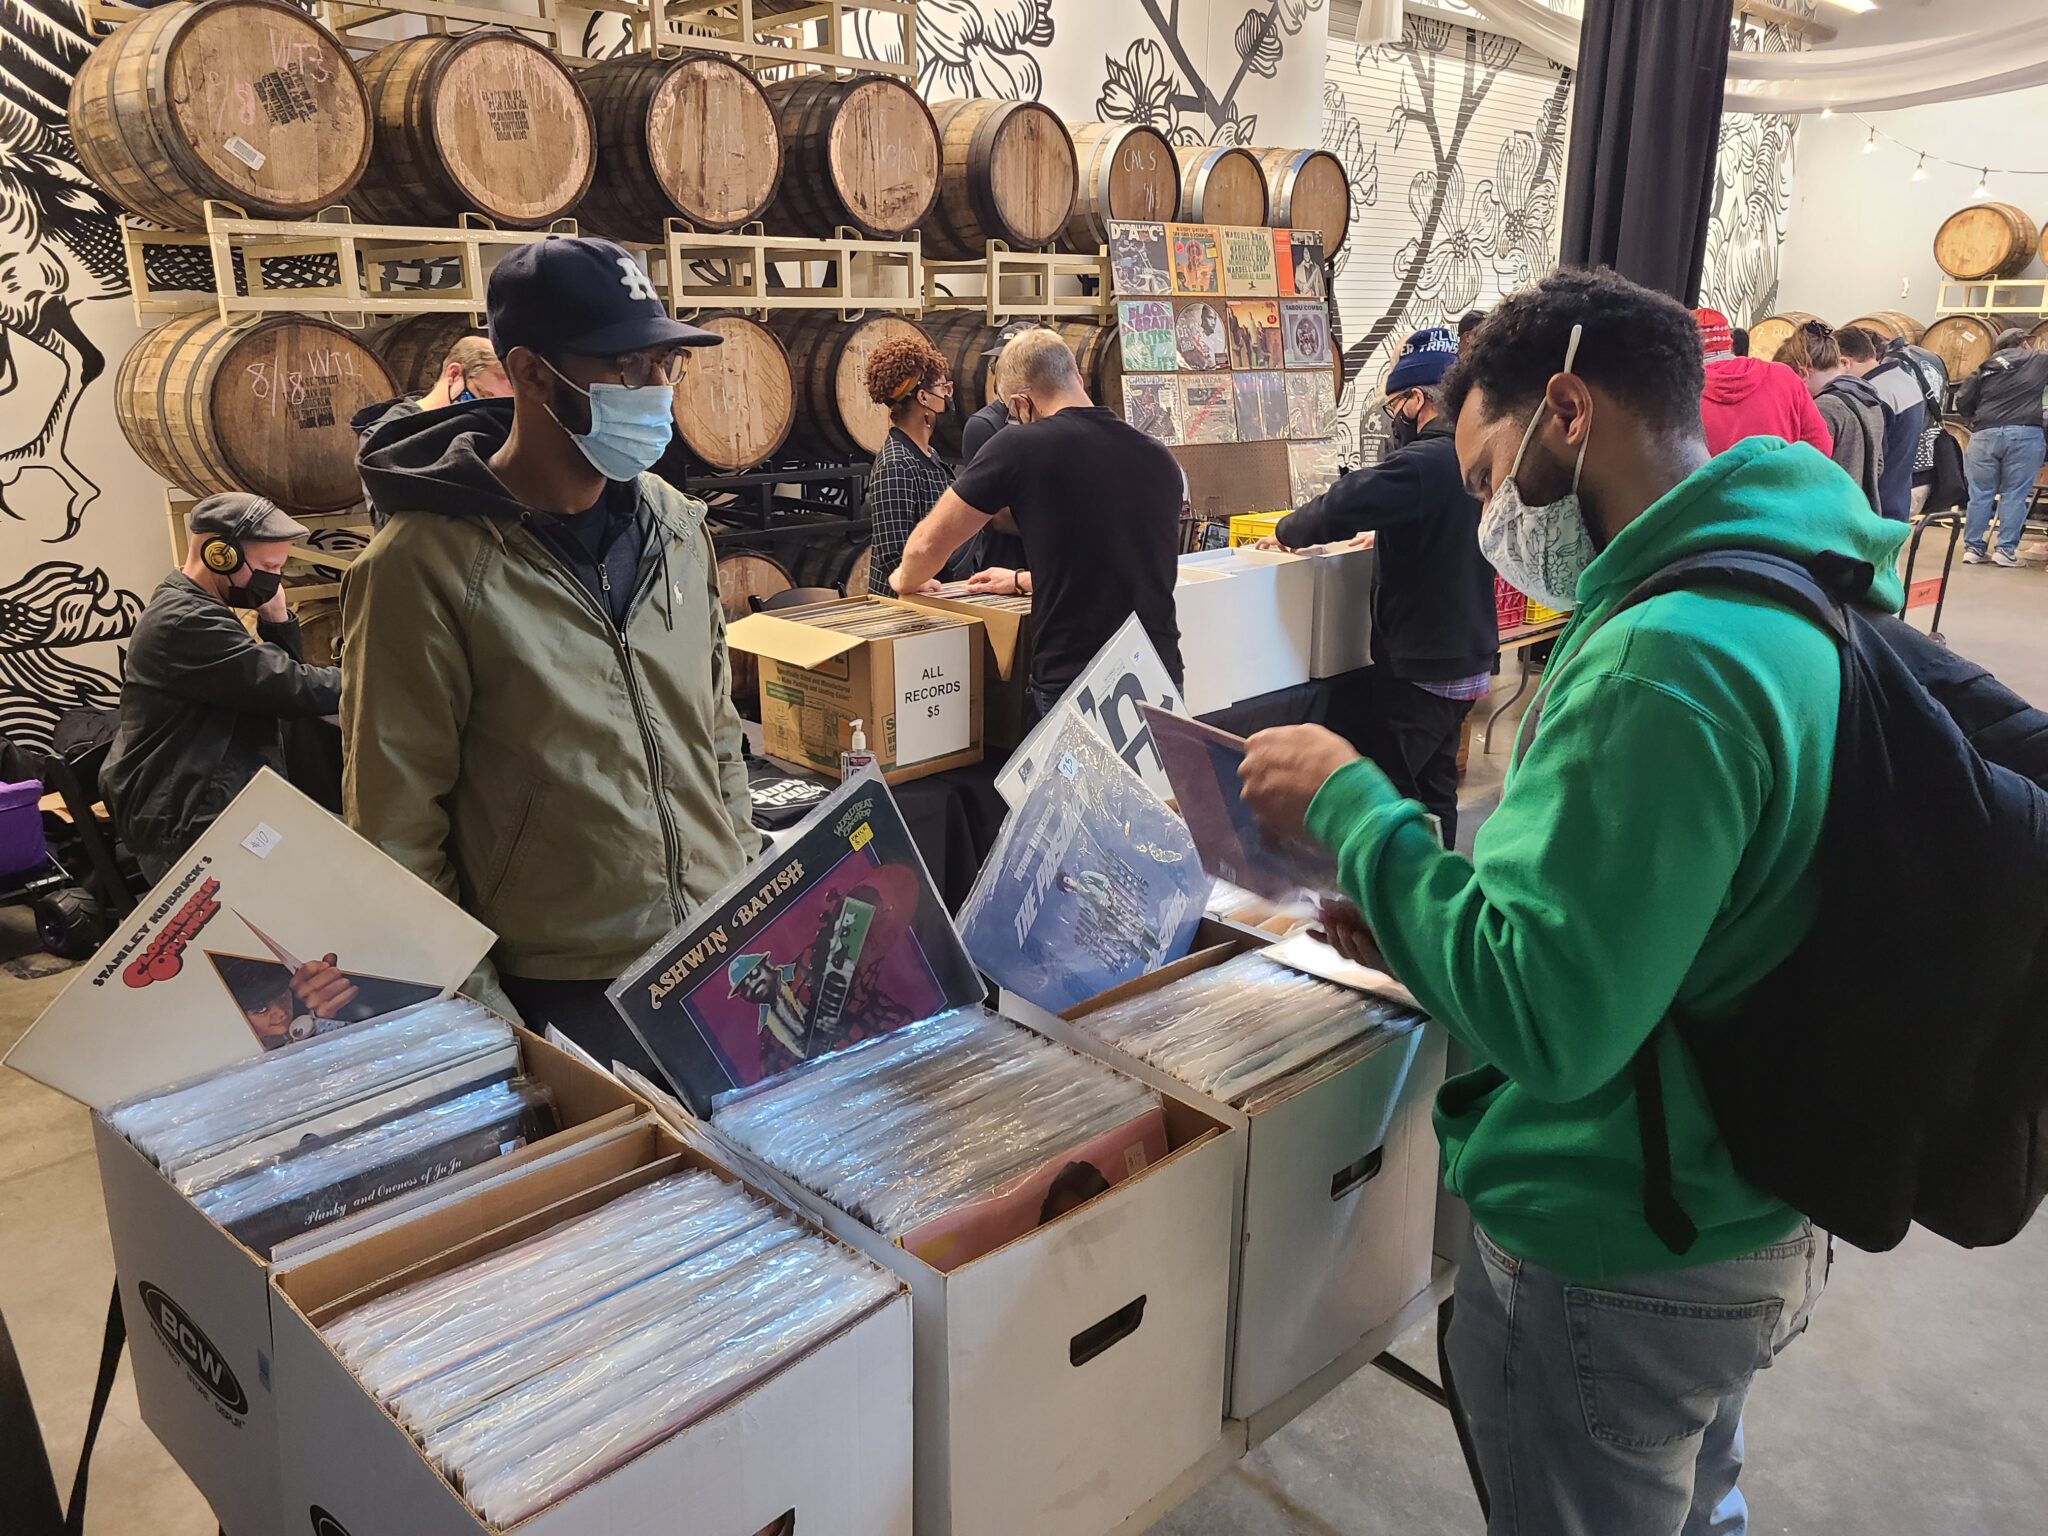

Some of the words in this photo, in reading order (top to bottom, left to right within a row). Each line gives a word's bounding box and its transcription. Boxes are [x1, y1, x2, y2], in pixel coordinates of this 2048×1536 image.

[904, 680, 961, 704] RECORDS
[921, 665, 944, 681] ALL
[927, 704, 940, 719] $5
[92, 923, 151, 987] STANLEY
[148, 855, 213, 925] KUBRICK'S
[122, 875, 221, 989] CLOCKWORK
[148, 899, 222, 982] ORANGE
[647, 925, 729, 1010] ASHWIN
[731, 858, 806, 928] BATISH
[304, 1203, 347, 1226] Plunky
[353, 1189, 376, 1207] and
[376, 1176, 418, 1199] Oneness
[420, 1164, 432, 1185] of
[161, 1301, 223, 1386] BCW
